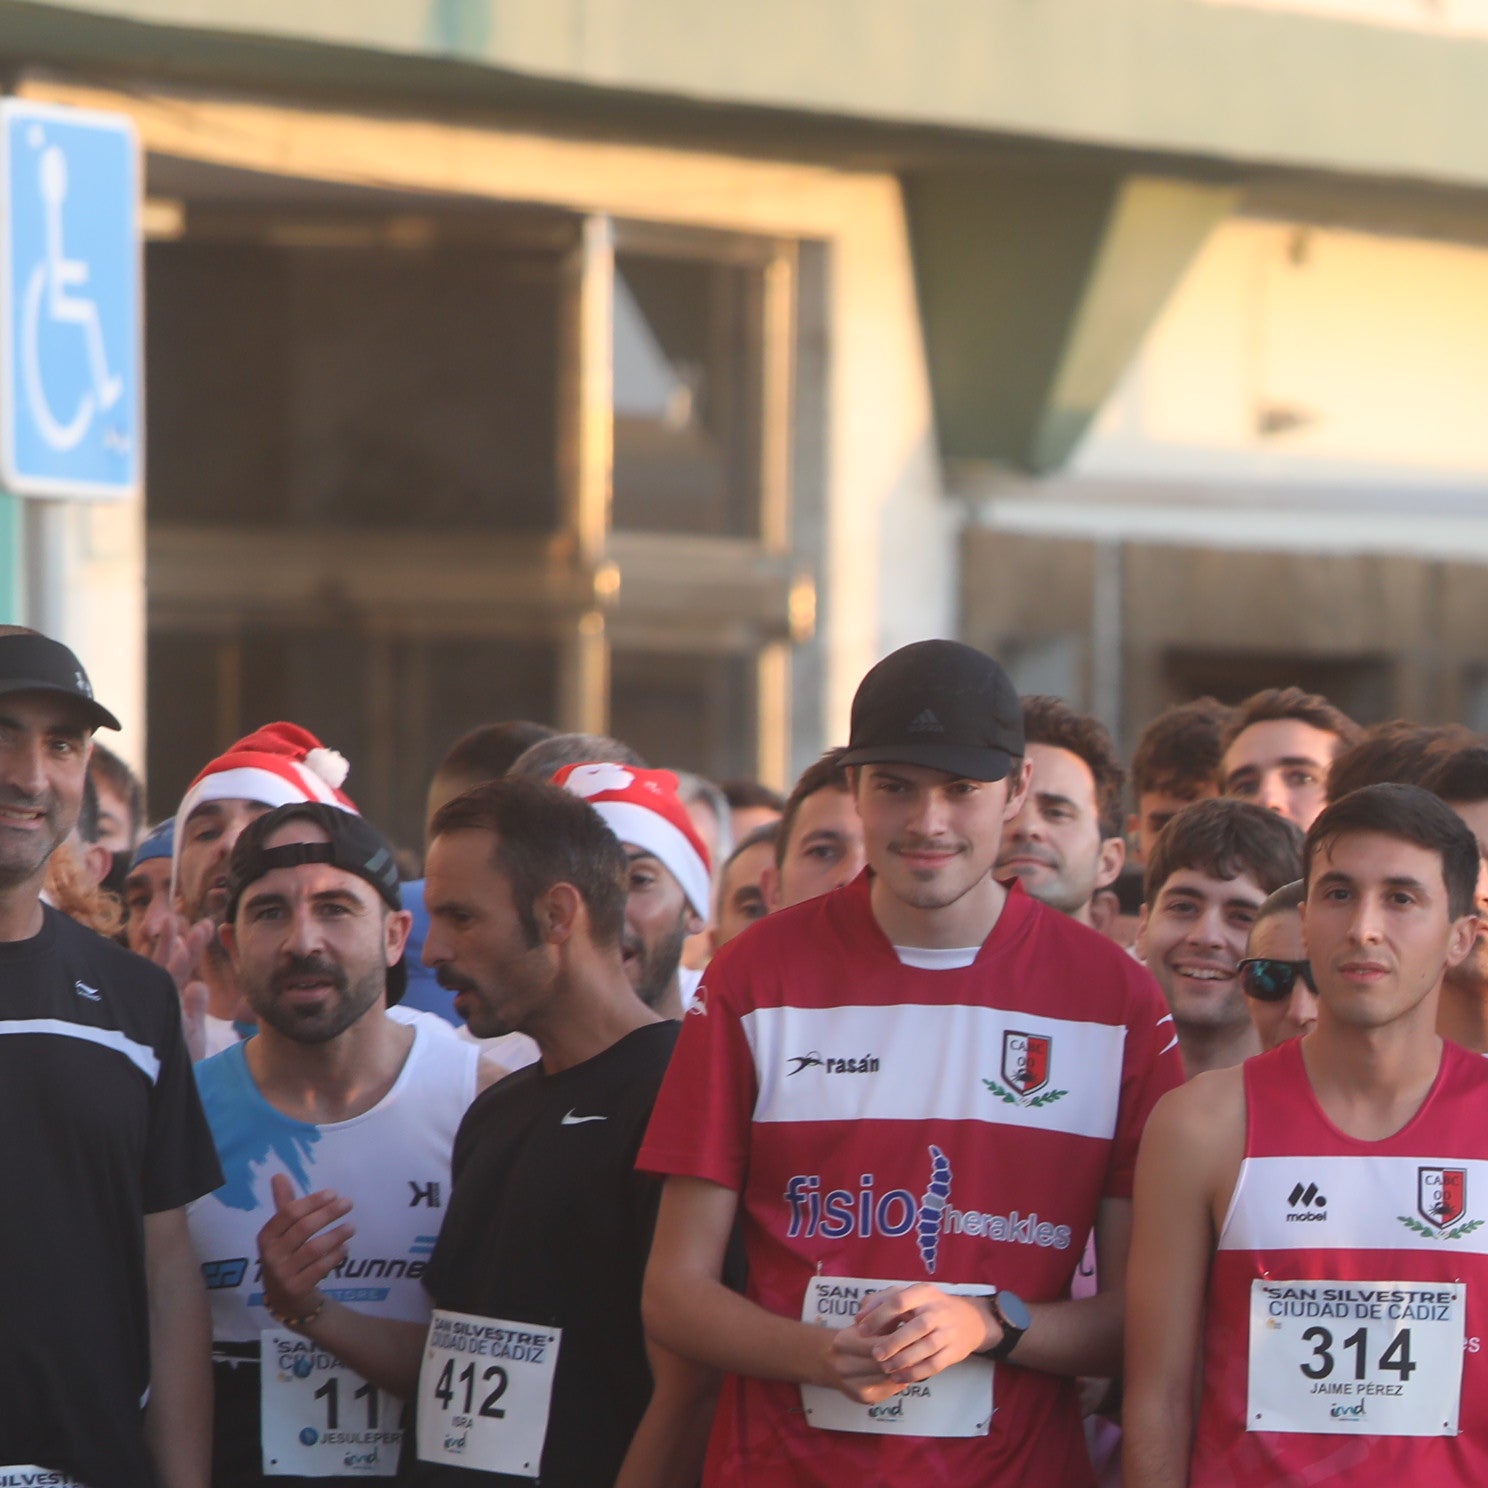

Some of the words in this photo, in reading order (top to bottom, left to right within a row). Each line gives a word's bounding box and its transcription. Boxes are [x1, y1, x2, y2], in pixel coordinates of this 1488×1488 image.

[825, 1053, 879, 1073] rasán
[784, 1174, 918, 1239] fisio
[1286, 1211, 1328, 1221] mobel
[816, 1284, 858, 1299] SAN
[1268, 1288, 1316, 1300] SAN
[1324, 1289, 1450, 1304] SILVESTRE
[1269, 1301, 1349, 1318] CIUDAD
[1356, 1303, 1382, 1319] DE
[1388, 1304, 1450, 1321] CADIZ
[453, 1322, 547, 1346] SILVESTRE
[470, 1338, 489, 1355] DE
[491, 1341, 544, 1363] CADIZ
[1300, 1325, 1416, 1381] 314
[435, 1358, 508, 1419] 412
[1310, 1383, 1352, 1395] JAIME
[1357, 1381, 1404, 1396] PÉREZ
[314, 1377, 403, 1430] 11
